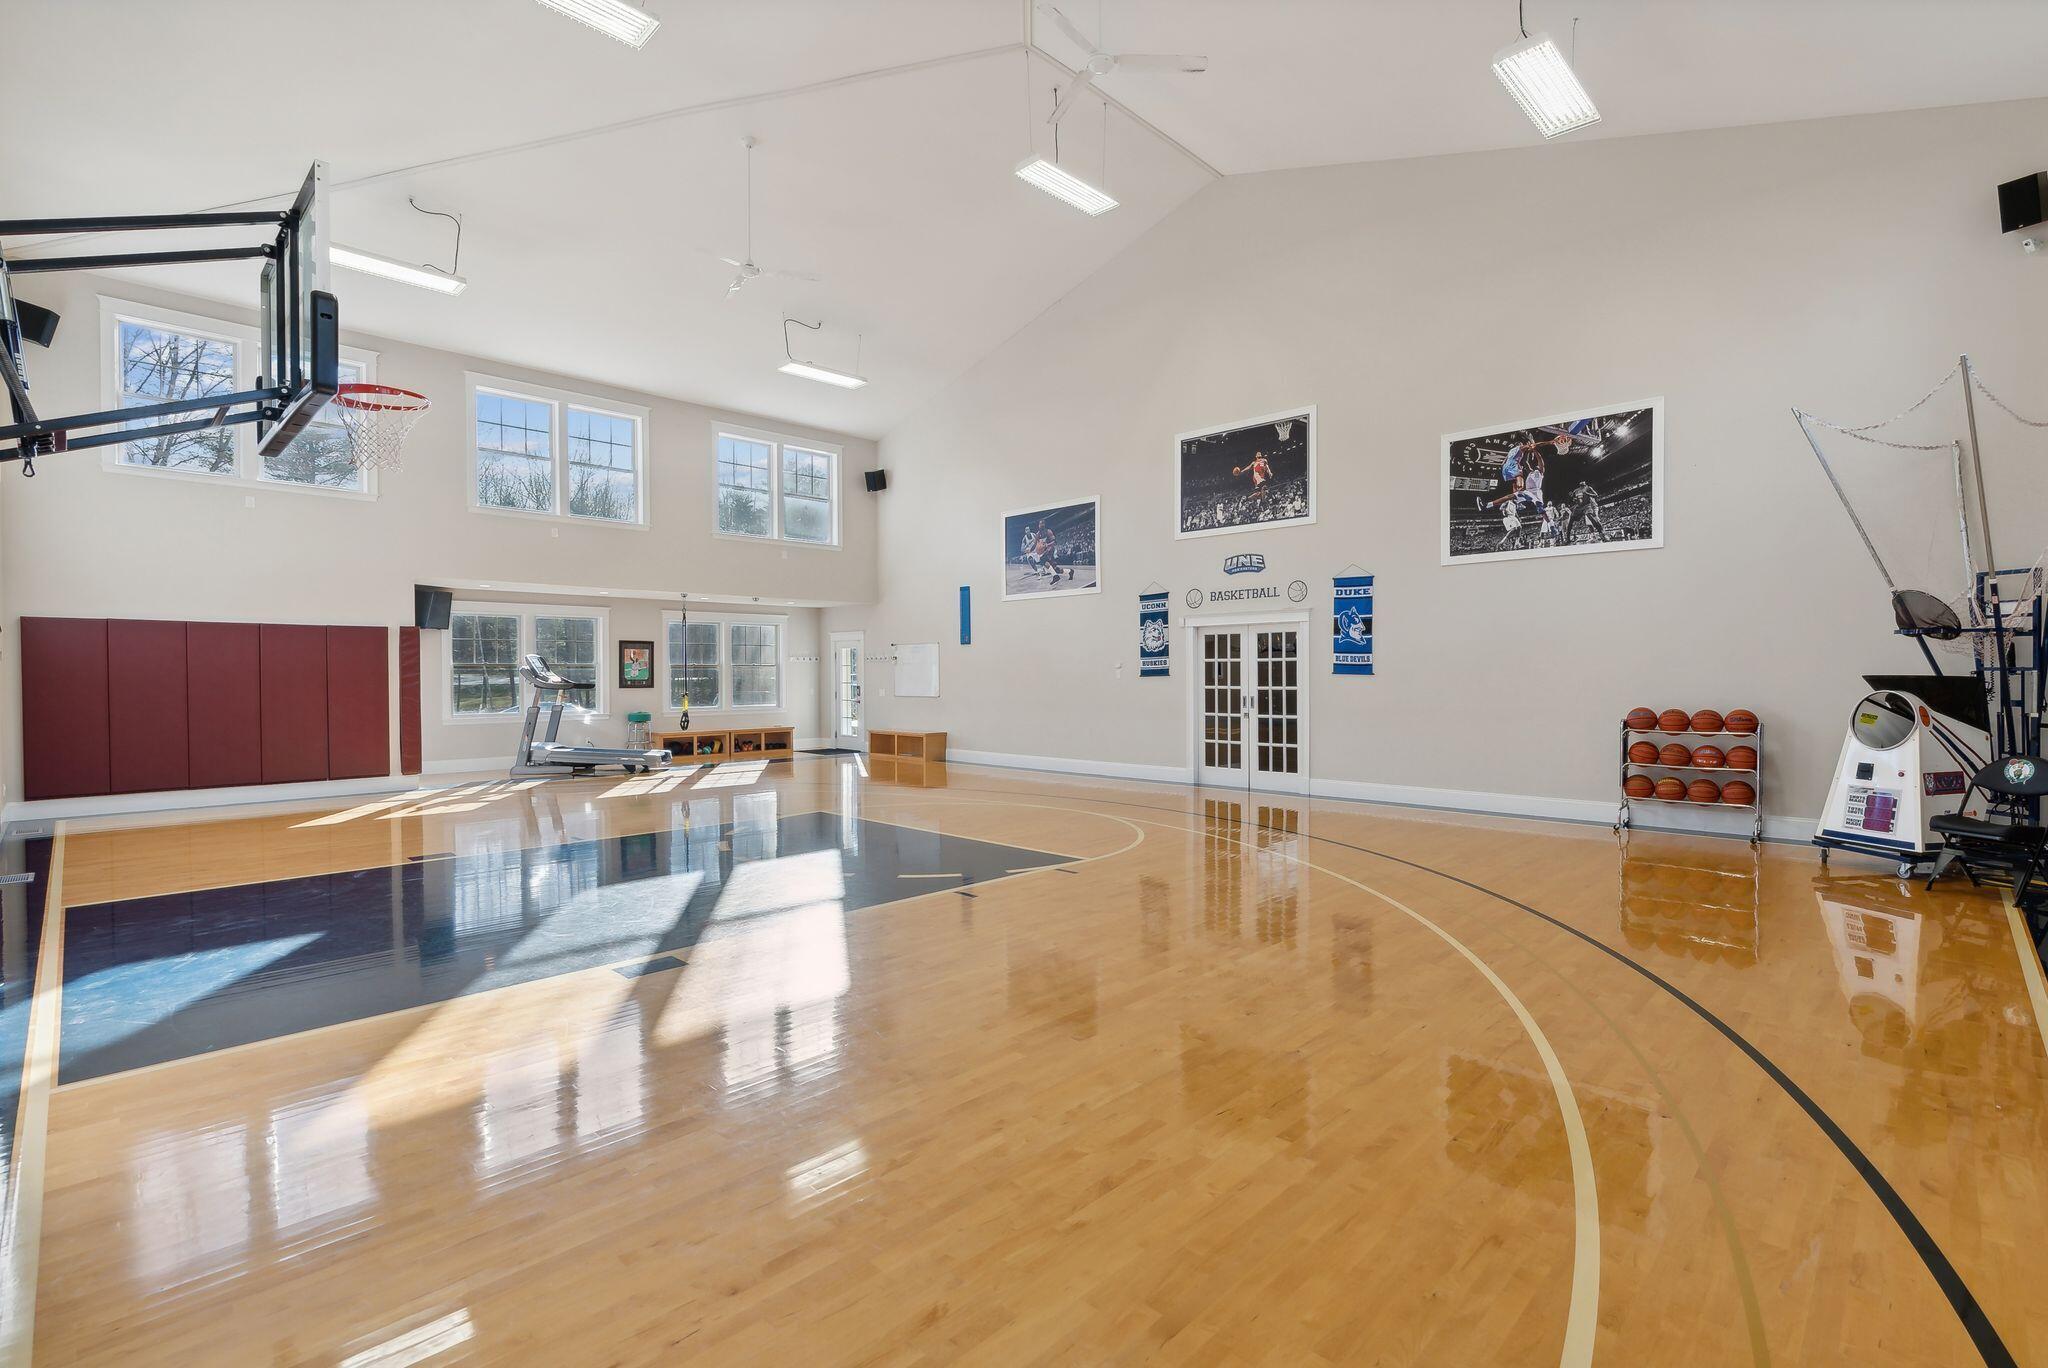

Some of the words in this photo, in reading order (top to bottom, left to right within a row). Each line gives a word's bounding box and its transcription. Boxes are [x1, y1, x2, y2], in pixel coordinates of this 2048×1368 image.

[1224, 554, 1265, 570] UNE
[1210, 587, 1280, 602] BASKETBALL
[1335, 588, 1370, 597] DUKE
[1141, 602, 1167, 610] UCONN
[1142, 659, 1168, 667] HUSKIES
[1350, 654, 1371, 663] DEVILS
